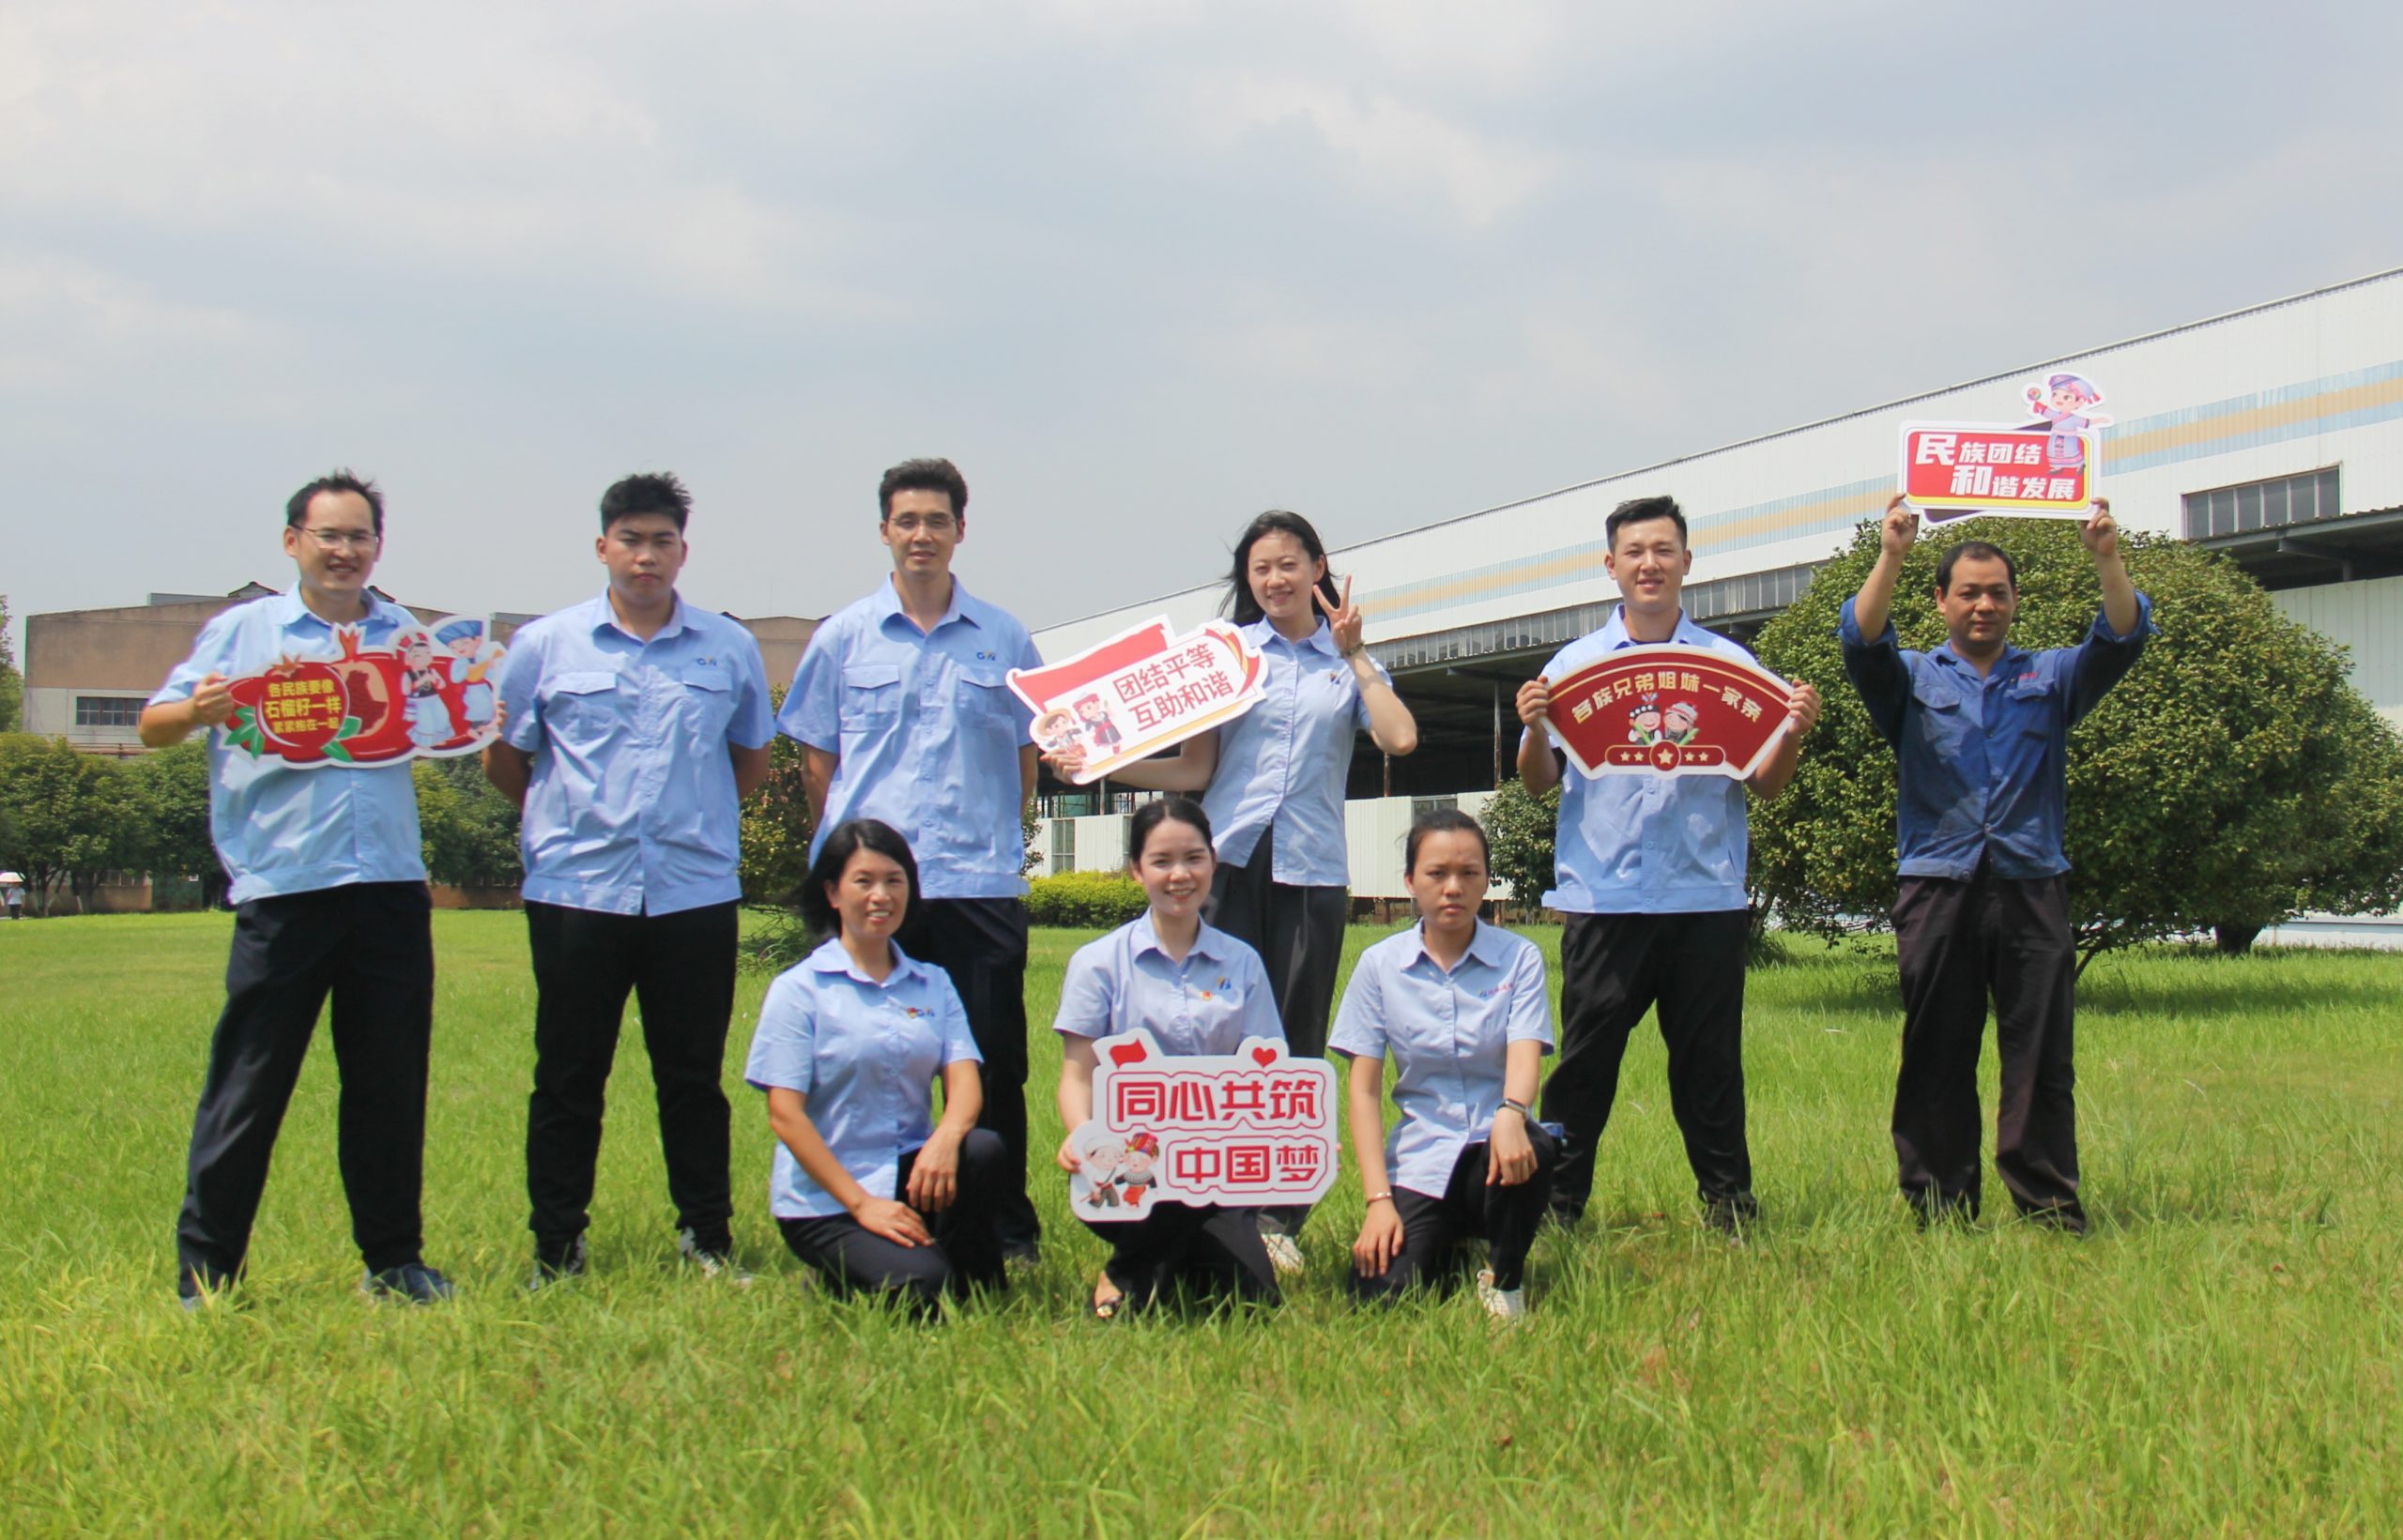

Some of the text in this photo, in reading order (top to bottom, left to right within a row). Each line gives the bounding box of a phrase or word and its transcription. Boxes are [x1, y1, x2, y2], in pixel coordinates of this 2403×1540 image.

[1915, 433, 2043, 466] 民族团结
[1950, 465, 2075, 500] 和谐发展
[1112, 643, 1216, 704] 团结平等
[265, 696, 343, 719] 石榴籽一样
[1128, 670, 1234, 732] 互助和谐
[1571, 671, 1763, 724] 各族兄弟姐妹一家亲
[1117, 1079, 1316, 1123] 同心共筑
[1175, 1143, 1319, 1184] 中国梦
